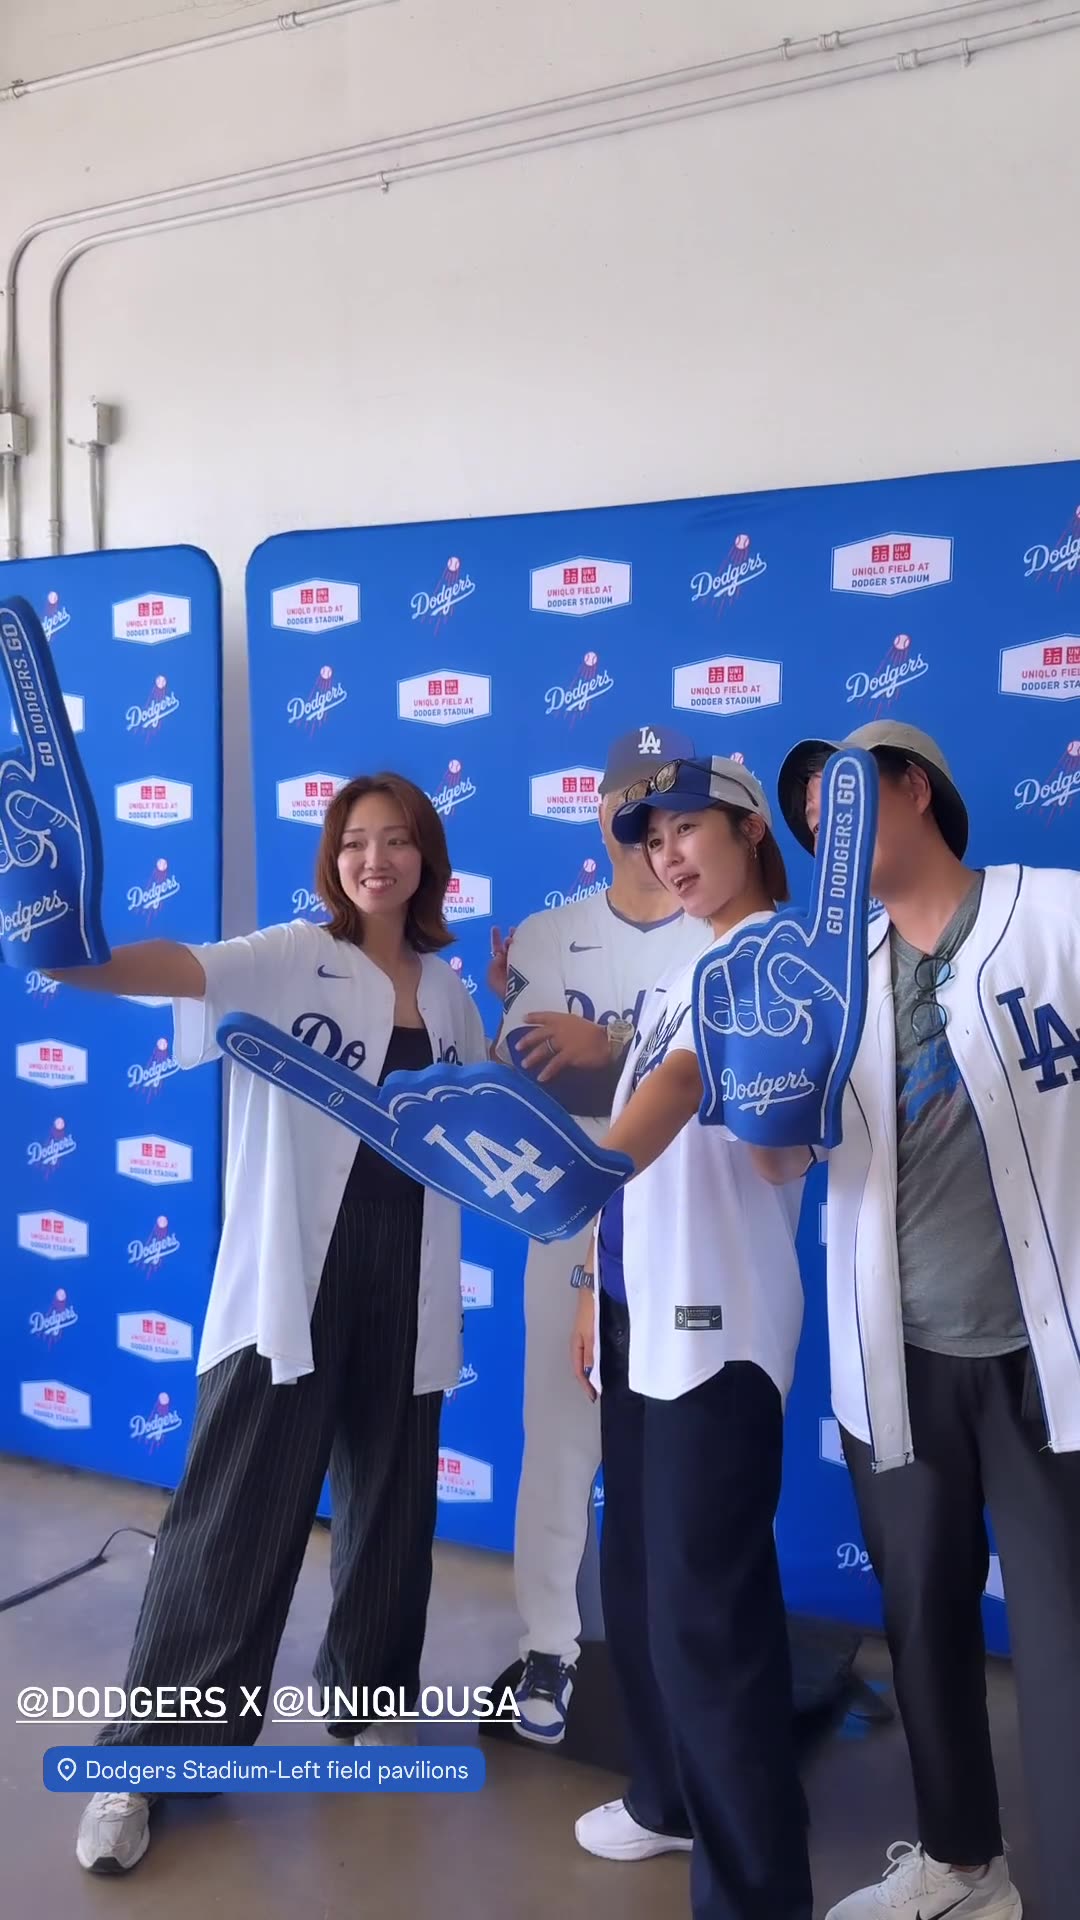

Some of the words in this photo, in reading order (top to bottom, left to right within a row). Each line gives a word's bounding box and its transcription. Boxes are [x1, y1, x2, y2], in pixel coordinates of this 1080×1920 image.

[852, 566, 885, 577] UNIQLO
[888, 563, 915, 574] FIELD
[918, 562, 930, 571] AT
[1023, 535, 1080, 577] Dodg
[547, 588, 575, 597] UNIQLO
[577, 586, 600, 595] FIELD
[603, 585, 612, 593] AT
[690, 552, 767, 602] Dodgers
[851, 578, 887, 588] DODGER
[890, 574, 930, 585] STADIUM
[410, 573, 476, 620] Dodgers
[547, 598, 577, 608] DODGER
[580, 596, 613, 606] STADIUM
[1, 623, 23, 652] GO
[846, 653, 929, 704] Dodgers
[1021, 681, 1060, 691] DODGER
[1022, 669, 1057, 680] UNIQLO
[1061, 668, 1080, 677] FIEL
[287, 682, 348, 724] Dodgers
[544, 669, 614, 715] Dodgers
[690, 687, 720, 695] UNIQLO
[723, 685, 748, 694] FIELD
[750, 685, 761, 693] AT
[690, 697, 723, 706] DODGER
[725, 696, 761, 705] STADIUM
[126, 691, 180, 732] Dodgers
[413, 709, 441, 717] DODGER
[443, 707, 474, 716] STADIUM
[37, 741, 56, 768] GO
[638, 726, 662, 755] LA
[423, 776, 477, 816] odgers
[547, 796, 574, 804] UNIQLO
[1014, 770, 1080, 810] Dodge
[546, 806, 576, 814] DODGER
[826, 905, 845, 936] GO
[836, 773, 857, 806] GO
[127, 874, 181, 912] Dodgers
[995, 986, 1080, 1093] LA
[127, 1057, 181, 1088] Dodgers
[720, 1067, 816, 1116] Dodgers
[27, 1134, 77, 1165] Dodgers
[422, 1123, 566, 1214] LA
[127, 1232, 181, 1265] Dodgers
[29, 1305, 79, 1336] Dodgers
[130, 1410, 183, 1441] Dodgers
